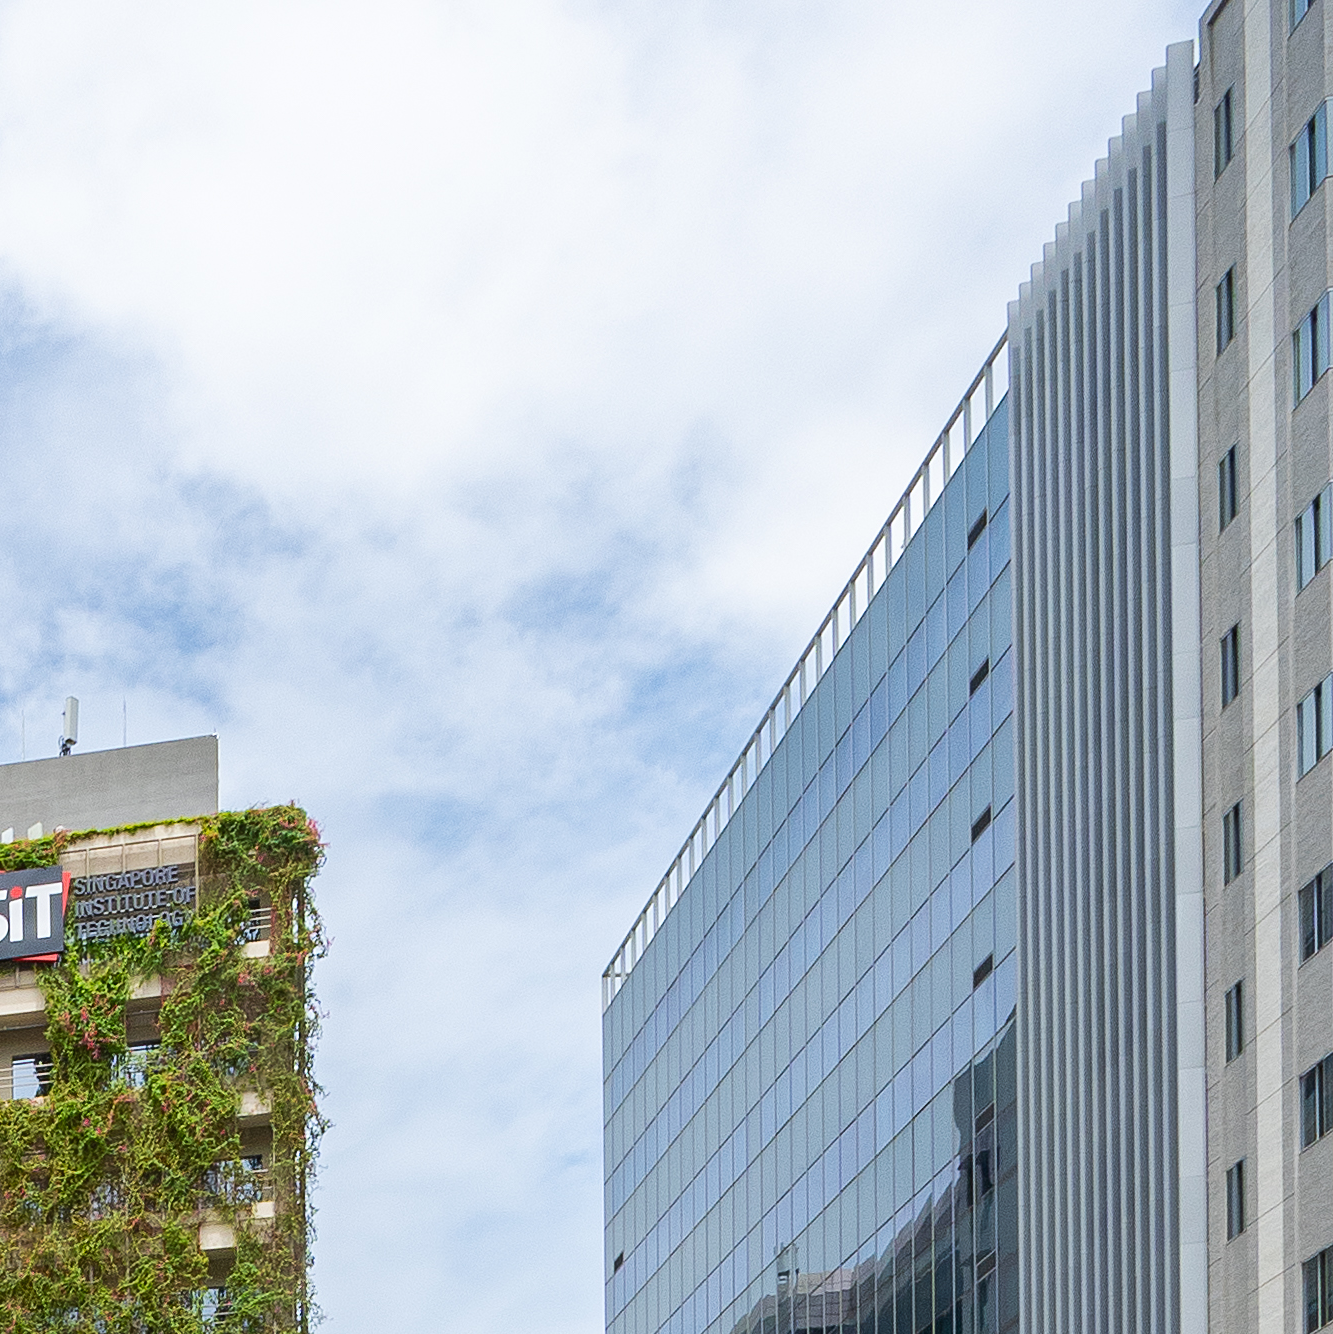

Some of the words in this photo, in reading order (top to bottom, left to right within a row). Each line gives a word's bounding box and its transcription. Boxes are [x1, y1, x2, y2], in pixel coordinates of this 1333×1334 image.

[74, 865, 179, 896] SINGAPORE
[75, 890, 167, 919] INSTITUTE
[172, 885, 196, 905] OF
[74, 908, 195, 940] TECHNOLOG
